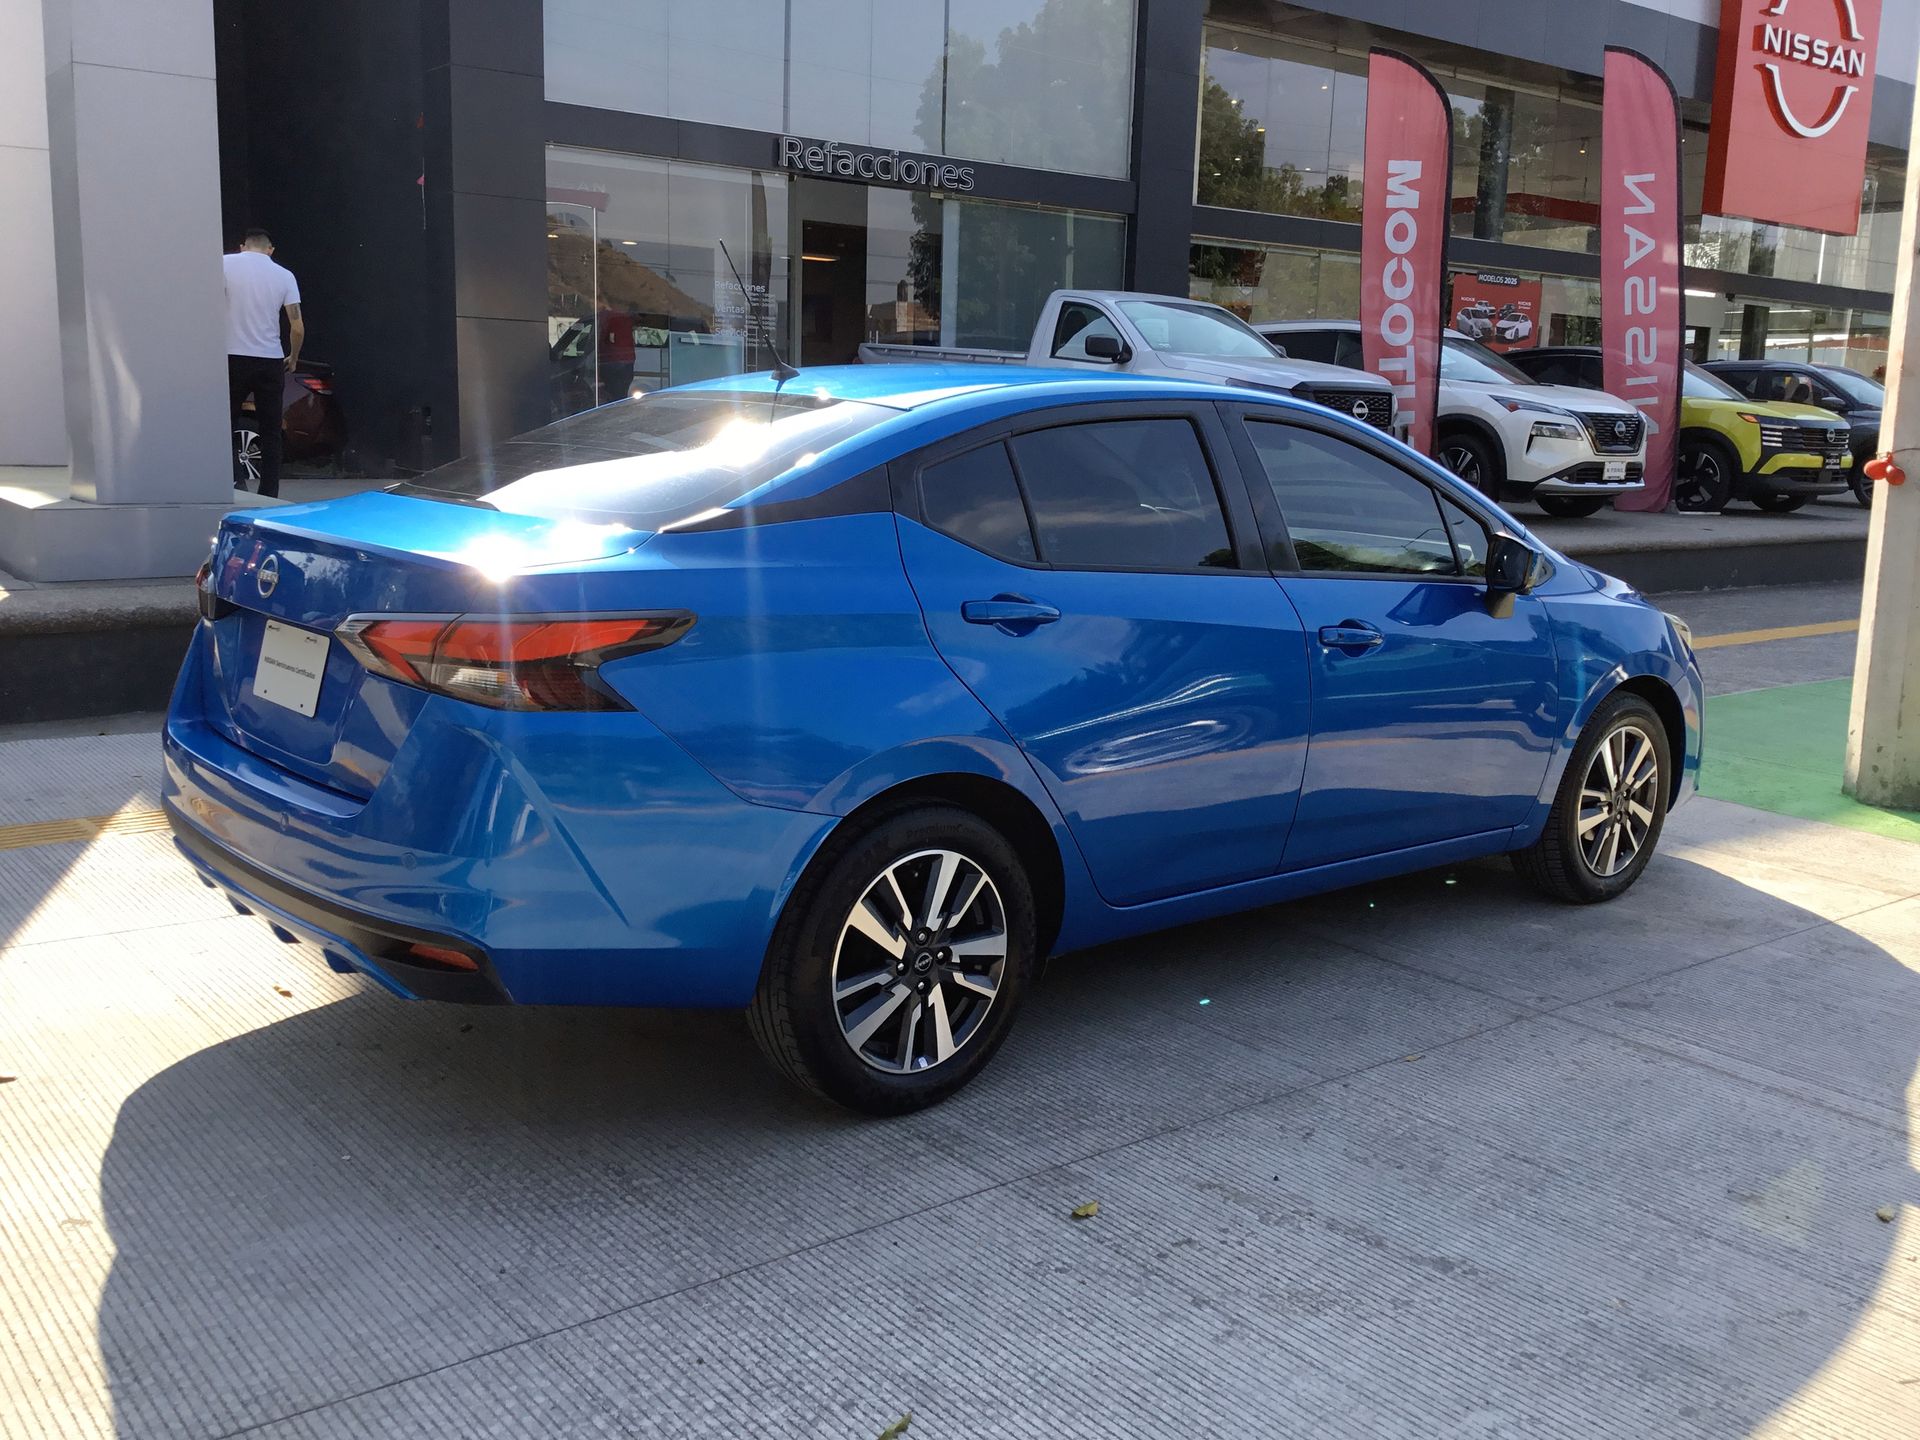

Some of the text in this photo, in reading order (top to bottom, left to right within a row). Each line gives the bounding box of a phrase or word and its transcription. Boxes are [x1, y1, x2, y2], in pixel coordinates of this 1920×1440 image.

[1763, 23, 1866, 77] NISSAN
[778, 136, 975, 191] Refacciones
[1478, 274, 1518, 285] MODELOS 2025
[715, 280, 766, 293] Refaccones
[715, 303, 745, 314] Ventas
[714, 327, 748, 338] Servicio
